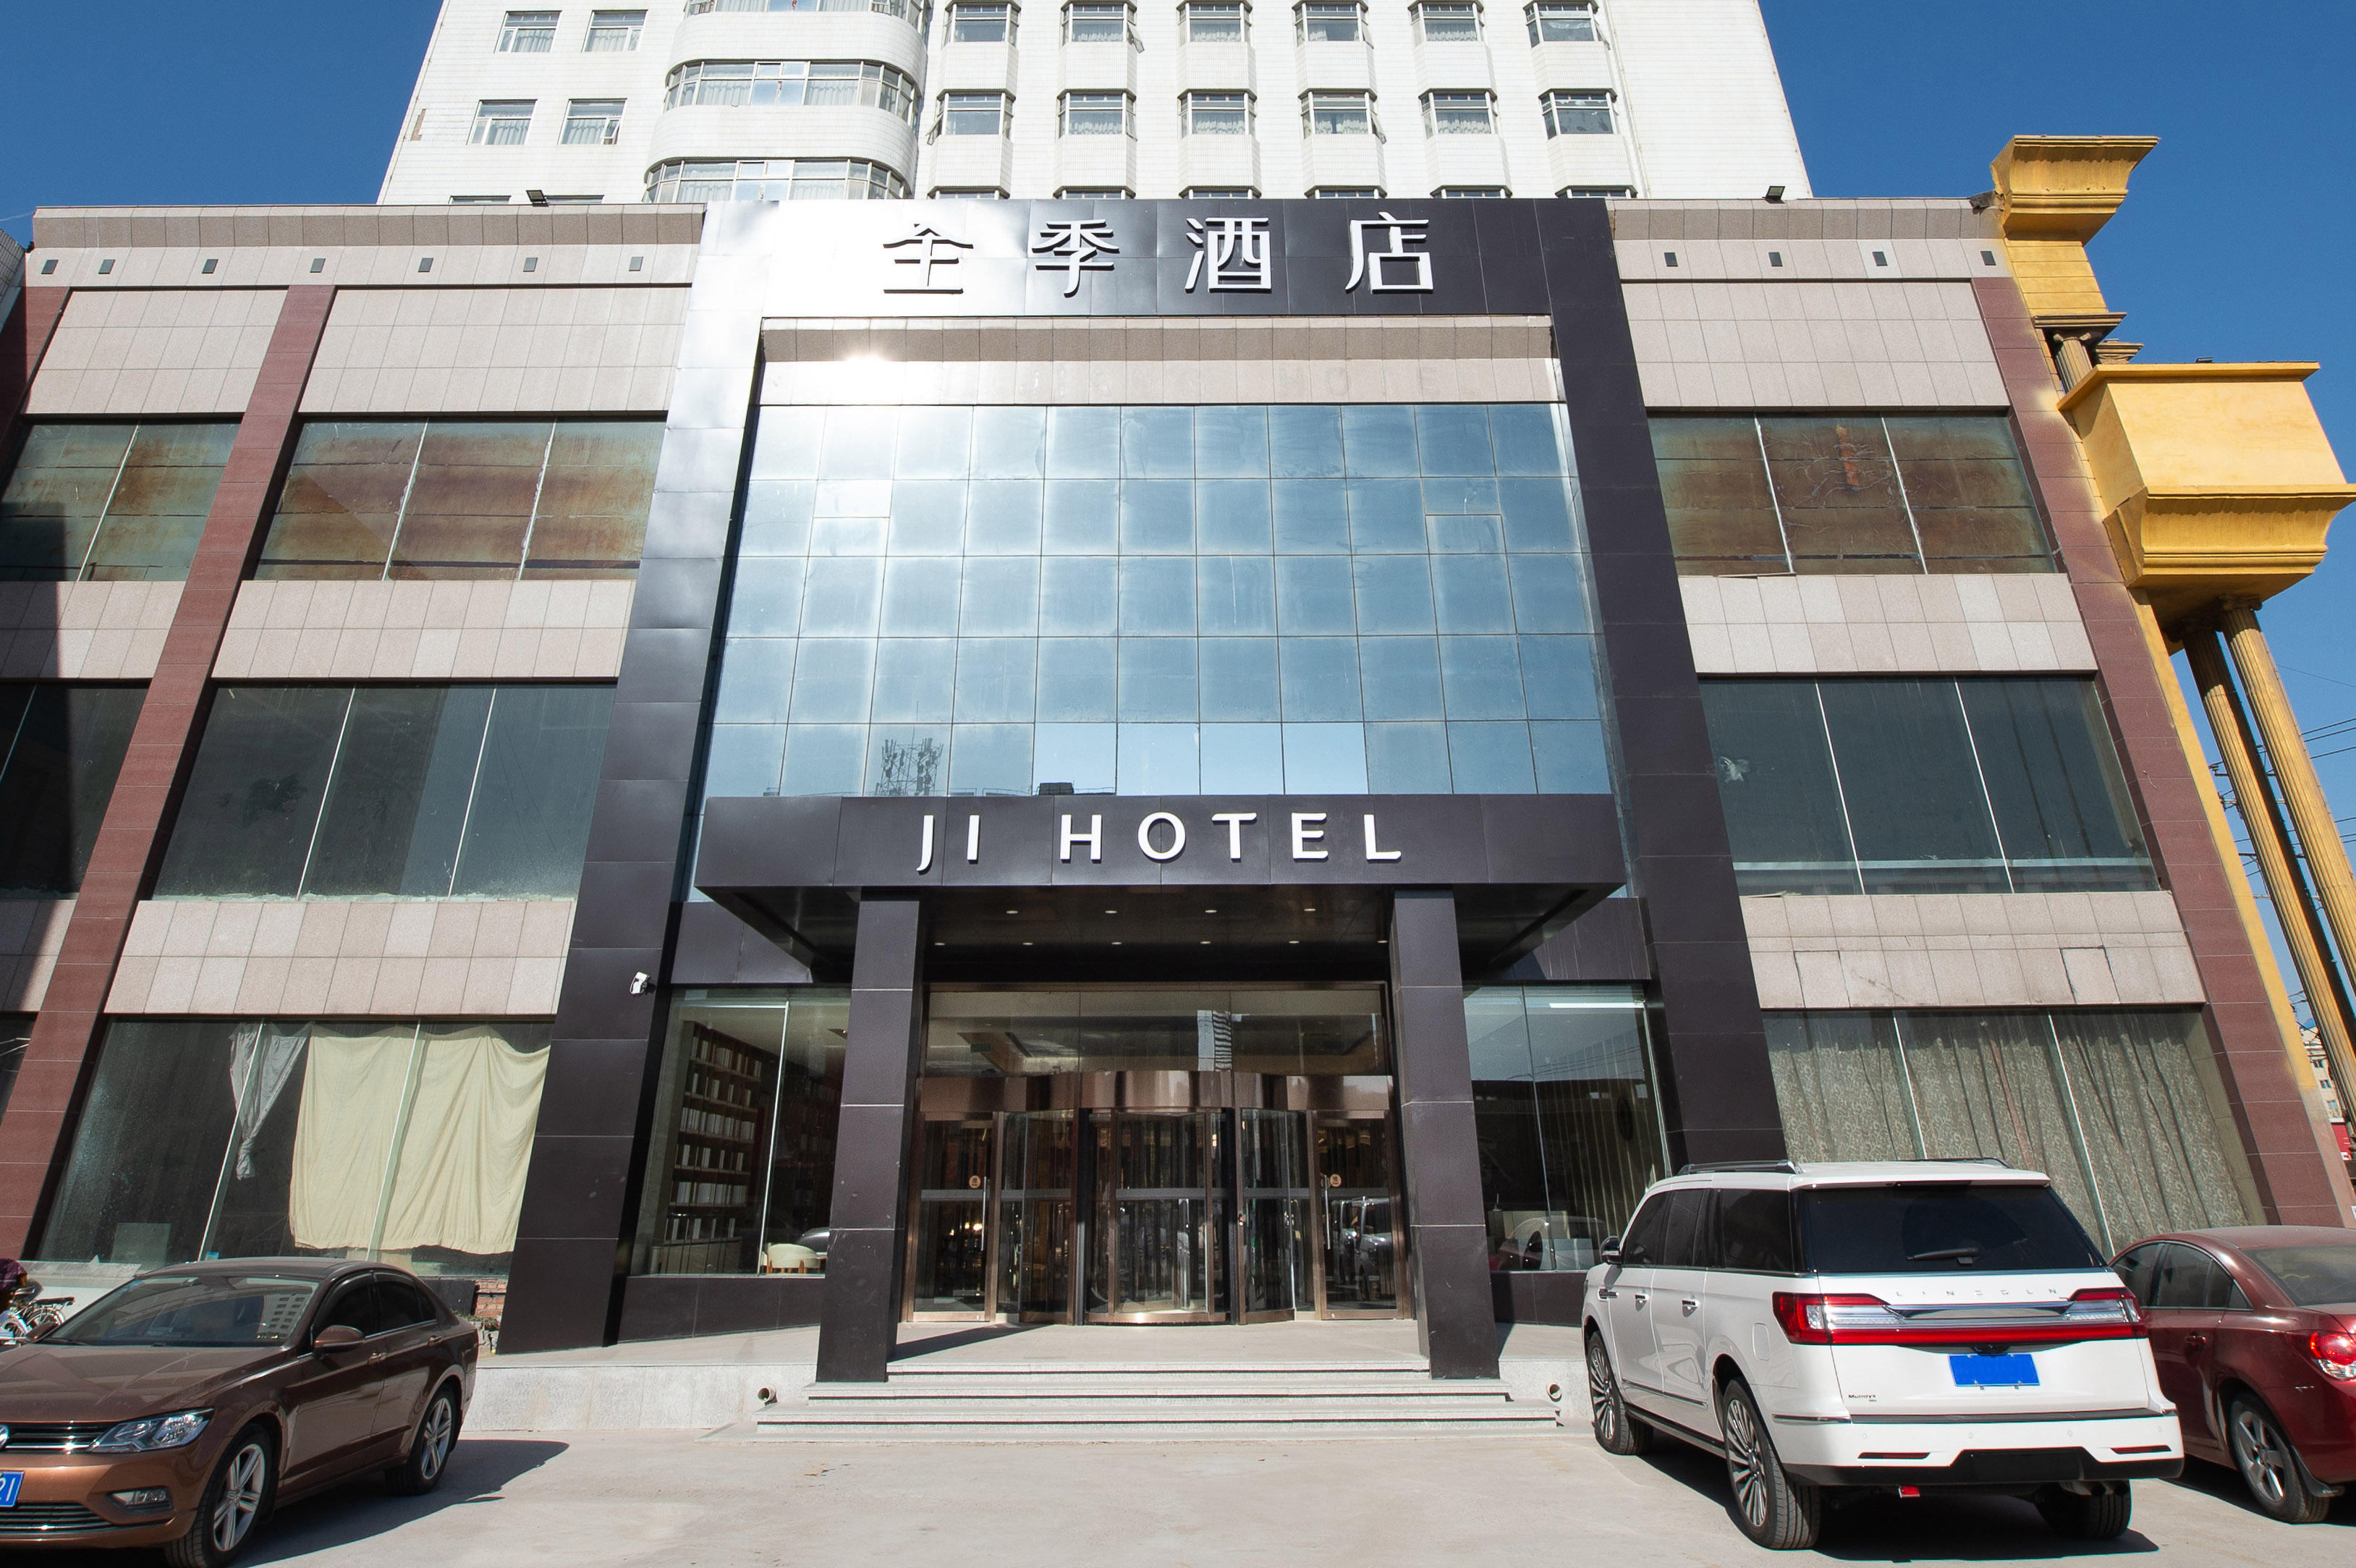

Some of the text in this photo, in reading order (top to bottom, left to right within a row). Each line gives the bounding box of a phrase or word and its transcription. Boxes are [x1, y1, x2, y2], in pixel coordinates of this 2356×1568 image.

[883, 211, 1435, 297] 全季酒店
[916, 812, 1402, 873] JI HOTEL
[1896, 1288, 2057, 1297] LINCOLN
